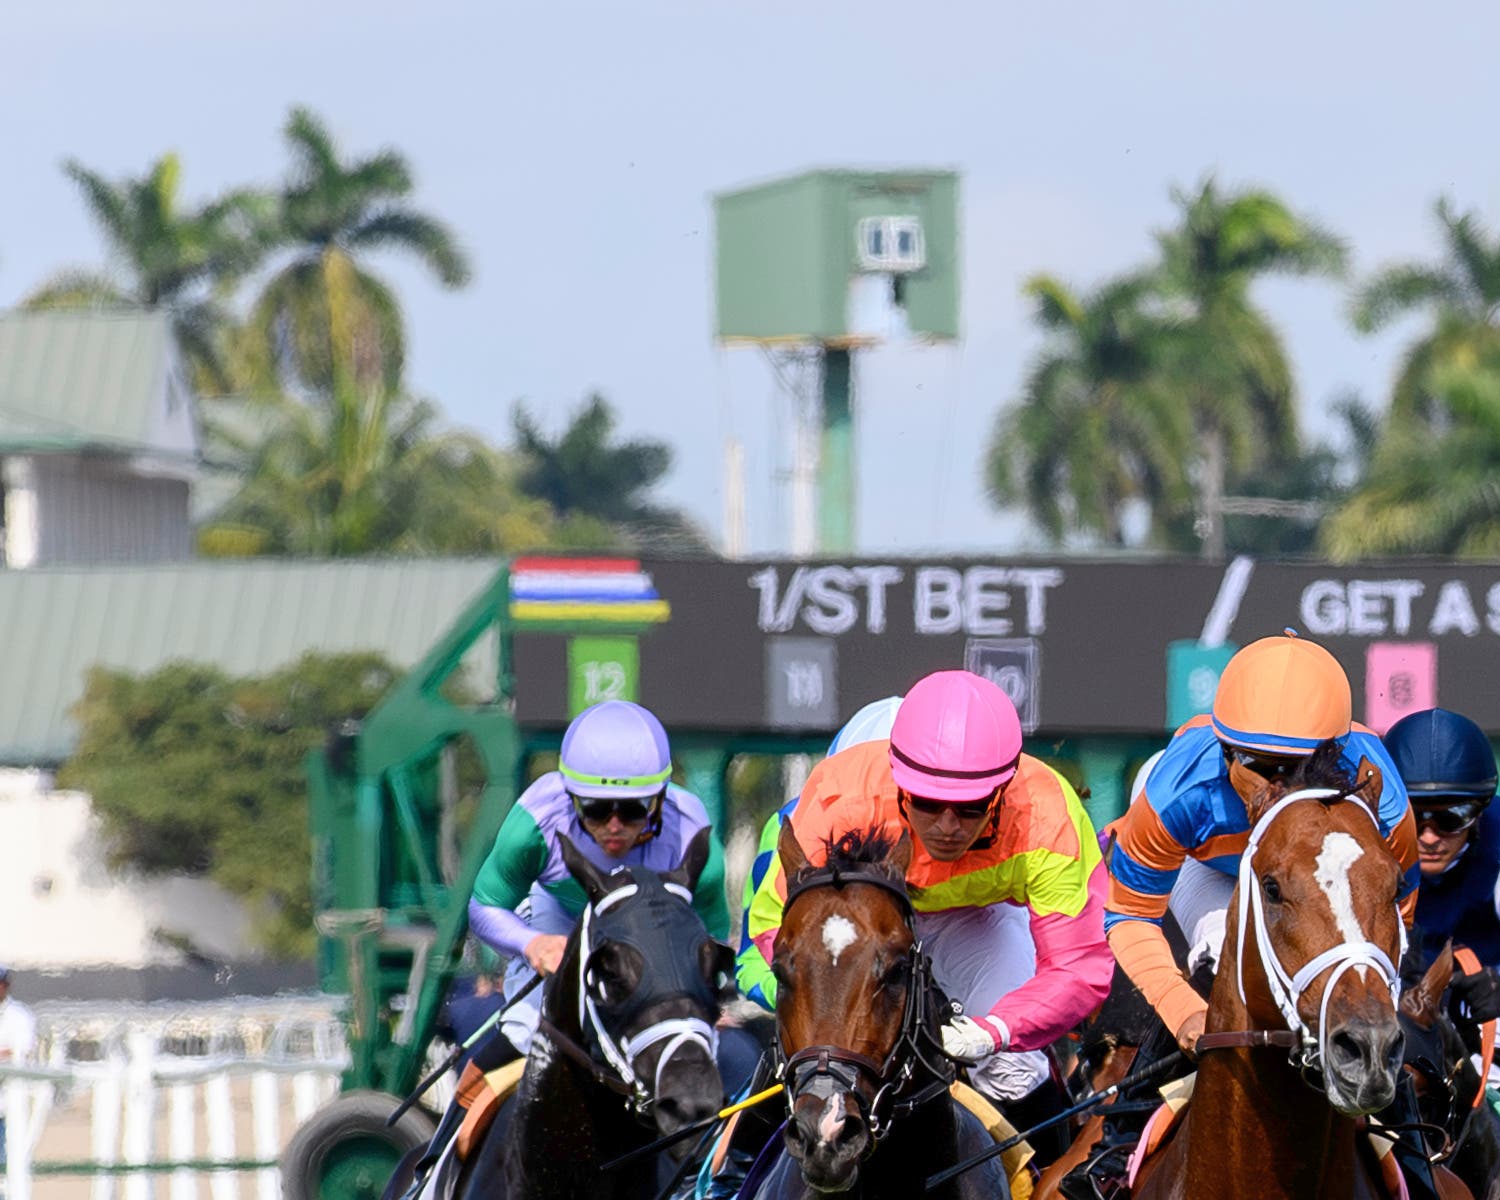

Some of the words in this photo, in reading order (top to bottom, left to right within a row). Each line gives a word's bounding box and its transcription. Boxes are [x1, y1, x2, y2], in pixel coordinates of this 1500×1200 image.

[749, 564, 903, 635] 1/ST
[914, 564, 1064, 635] BET
[1301, 578, 1425, 637] GET
[1428, 579, 1481, 638] A
[583, 661, 627, 702] 12
